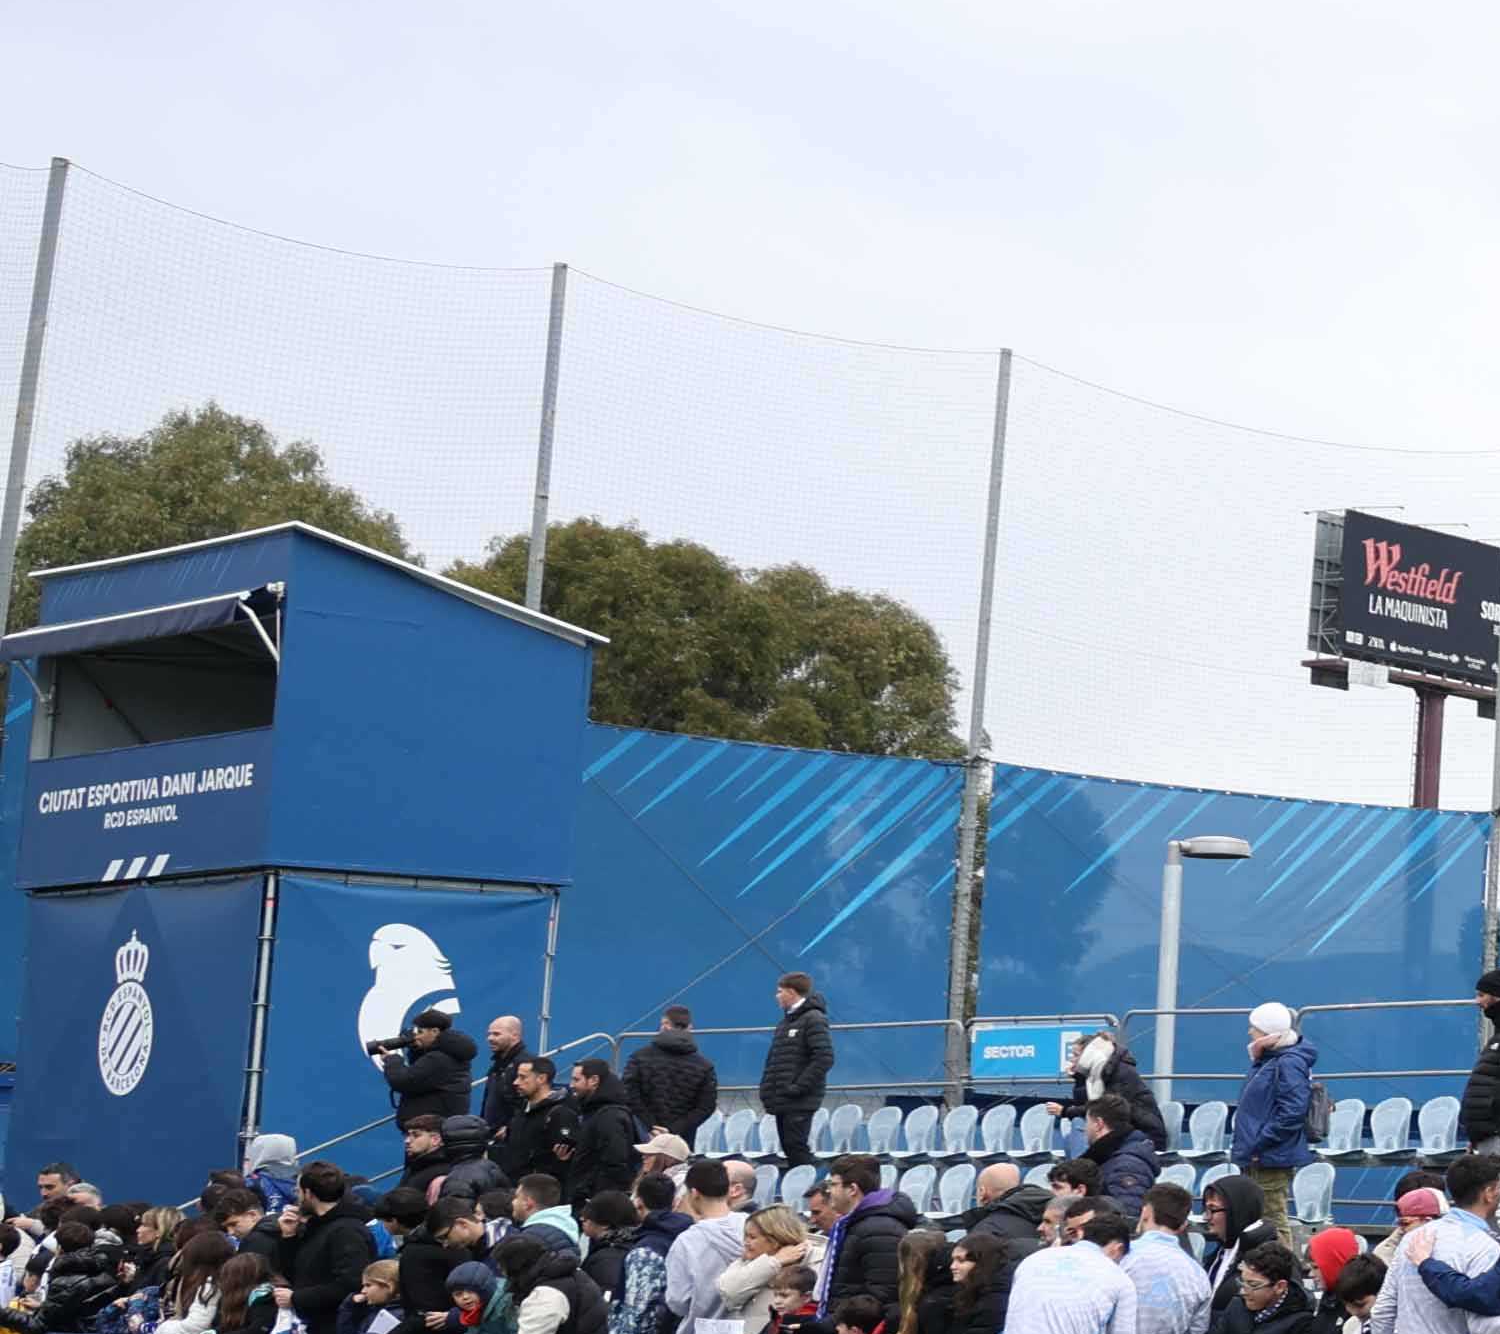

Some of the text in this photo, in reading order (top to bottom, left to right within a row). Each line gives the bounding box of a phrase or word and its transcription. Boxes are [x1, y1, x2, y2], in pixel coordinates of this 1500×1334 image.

[1361, 537, 1463, 604] Westfield
[1368, 593, 1448, 629] LA MAQUINISTA
[39, 763, 254, 814] CIUTAT ESPORTIVA DANI JARQUE
[103, 804, 178, 829] RCD ESPANYOL
[983, 1044, 1035, 1059] SECTOR
